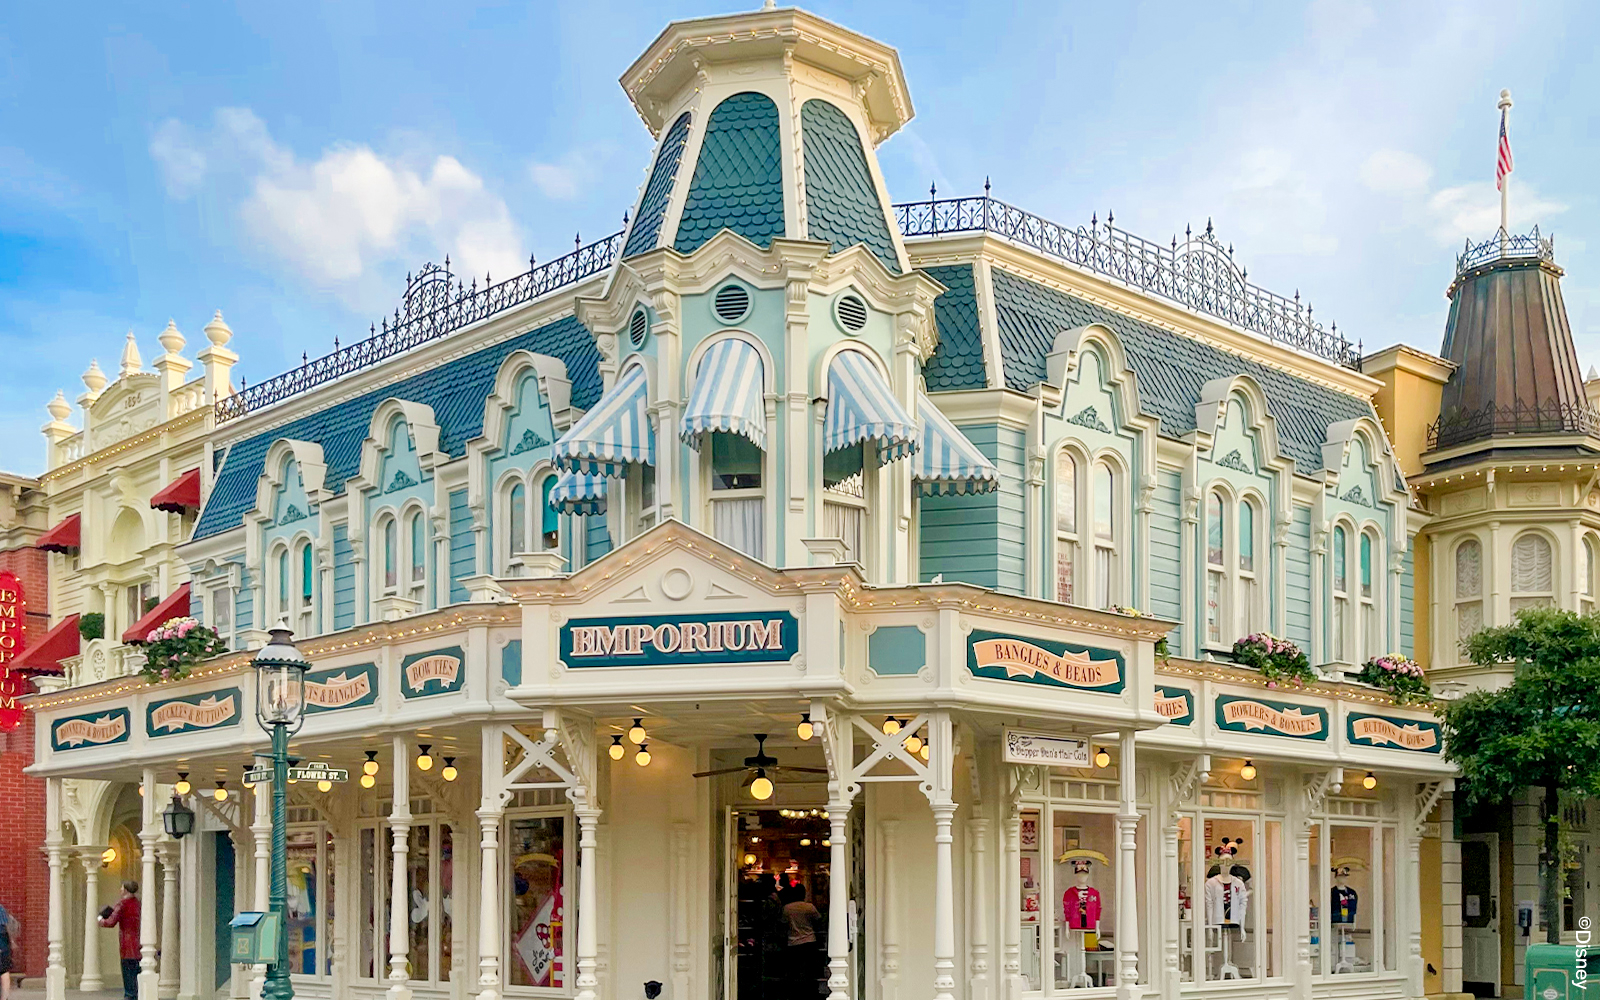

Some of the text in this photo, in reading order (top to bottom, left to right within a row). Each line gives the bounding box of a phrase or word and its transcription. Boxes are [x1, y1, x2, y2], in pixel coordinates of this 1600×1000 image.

[570, 619, 783, 656] EMPORIUM
[412, 659, 454, 681] BOW TIES
[995, 643, 1102, 682] BANGLES & BEADS
[320, 687, 326, 703] &
[328, 678, 367, 704] BANGLES
[157, 701, 229, 724] BUCKLES & BUTTONS
[1231, 703, 1316, 732] BOWLERS & BONNETS
[1363, 721, 1396, 739] BUTTONS
[1406, 733, 1425, 746] BOWS
[296, 770, 340, 780] FLOWER ST.
